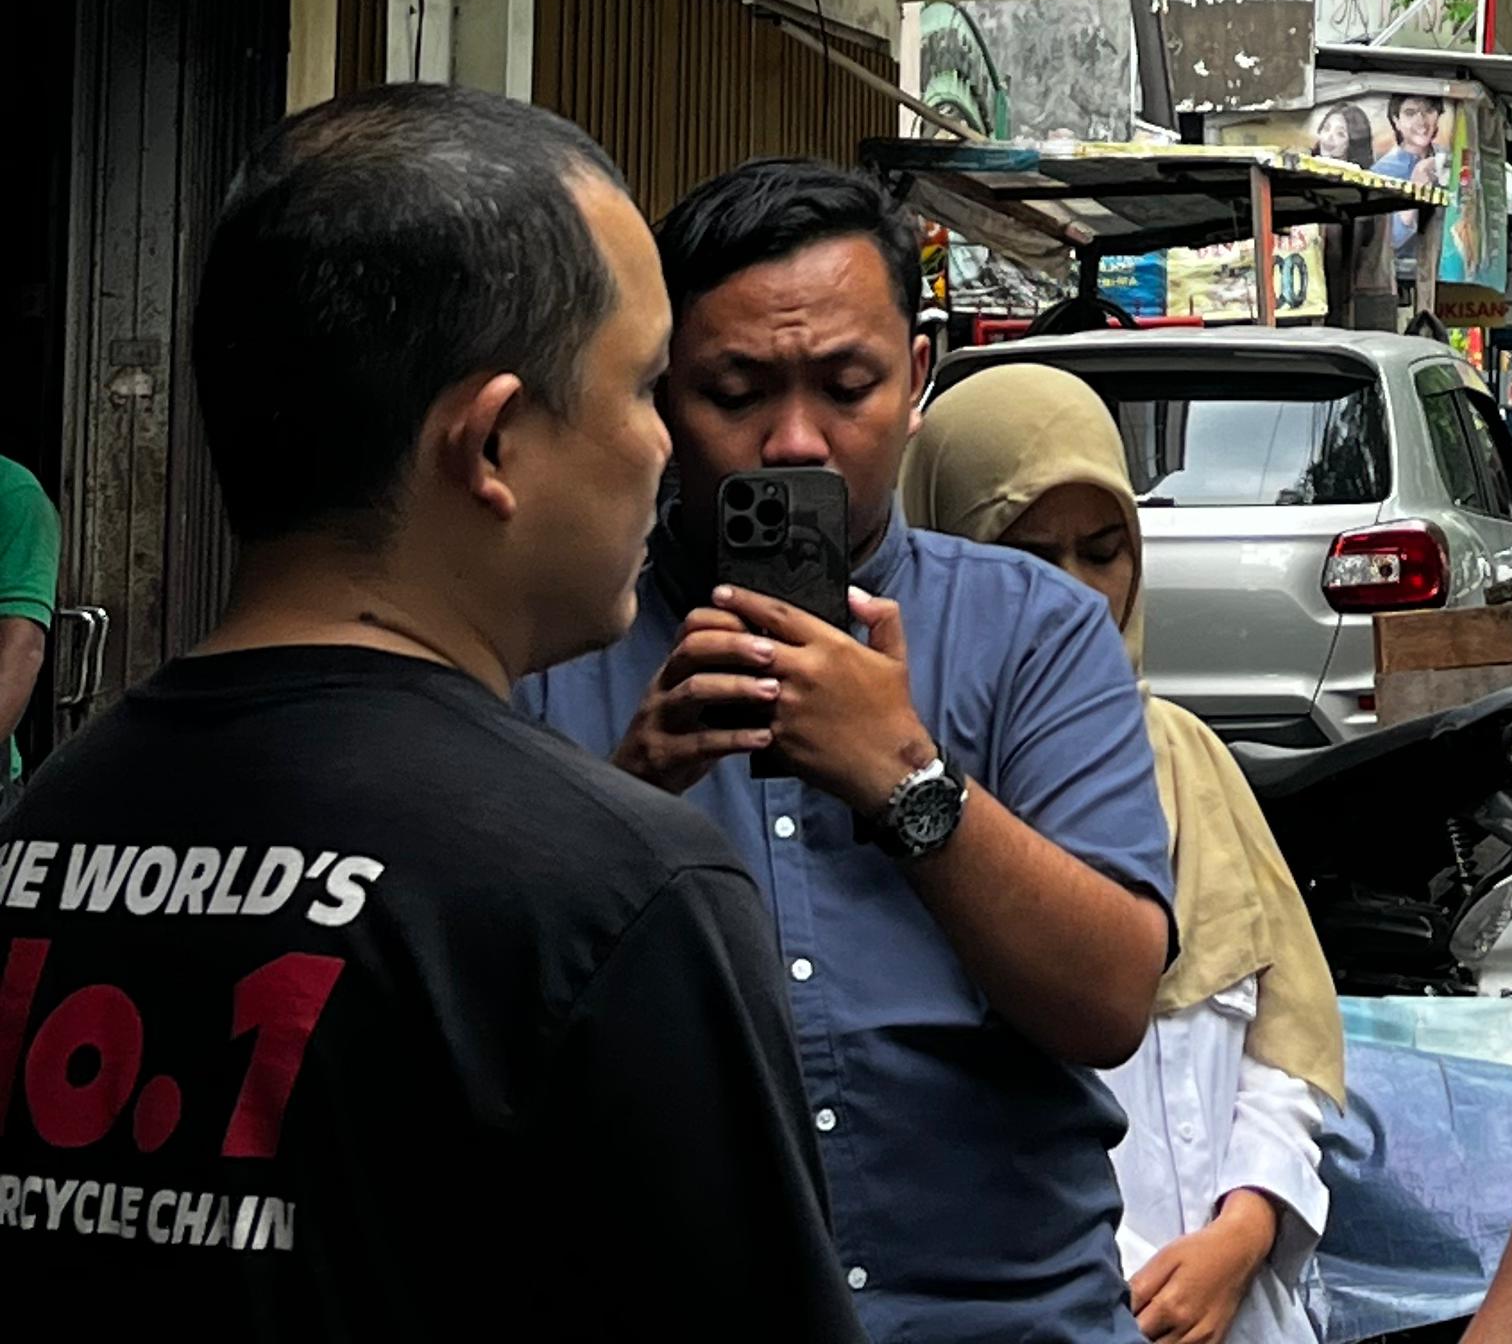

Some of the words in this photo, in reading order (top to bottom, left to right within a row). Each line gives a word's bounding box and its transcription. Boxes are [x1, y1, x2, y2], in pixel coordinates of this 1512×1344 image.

[59, 842, 386, 927] WORLD'S
[222, 951, 347, 1160] 1
[147, 1188, 296, 1250] CHAIN
